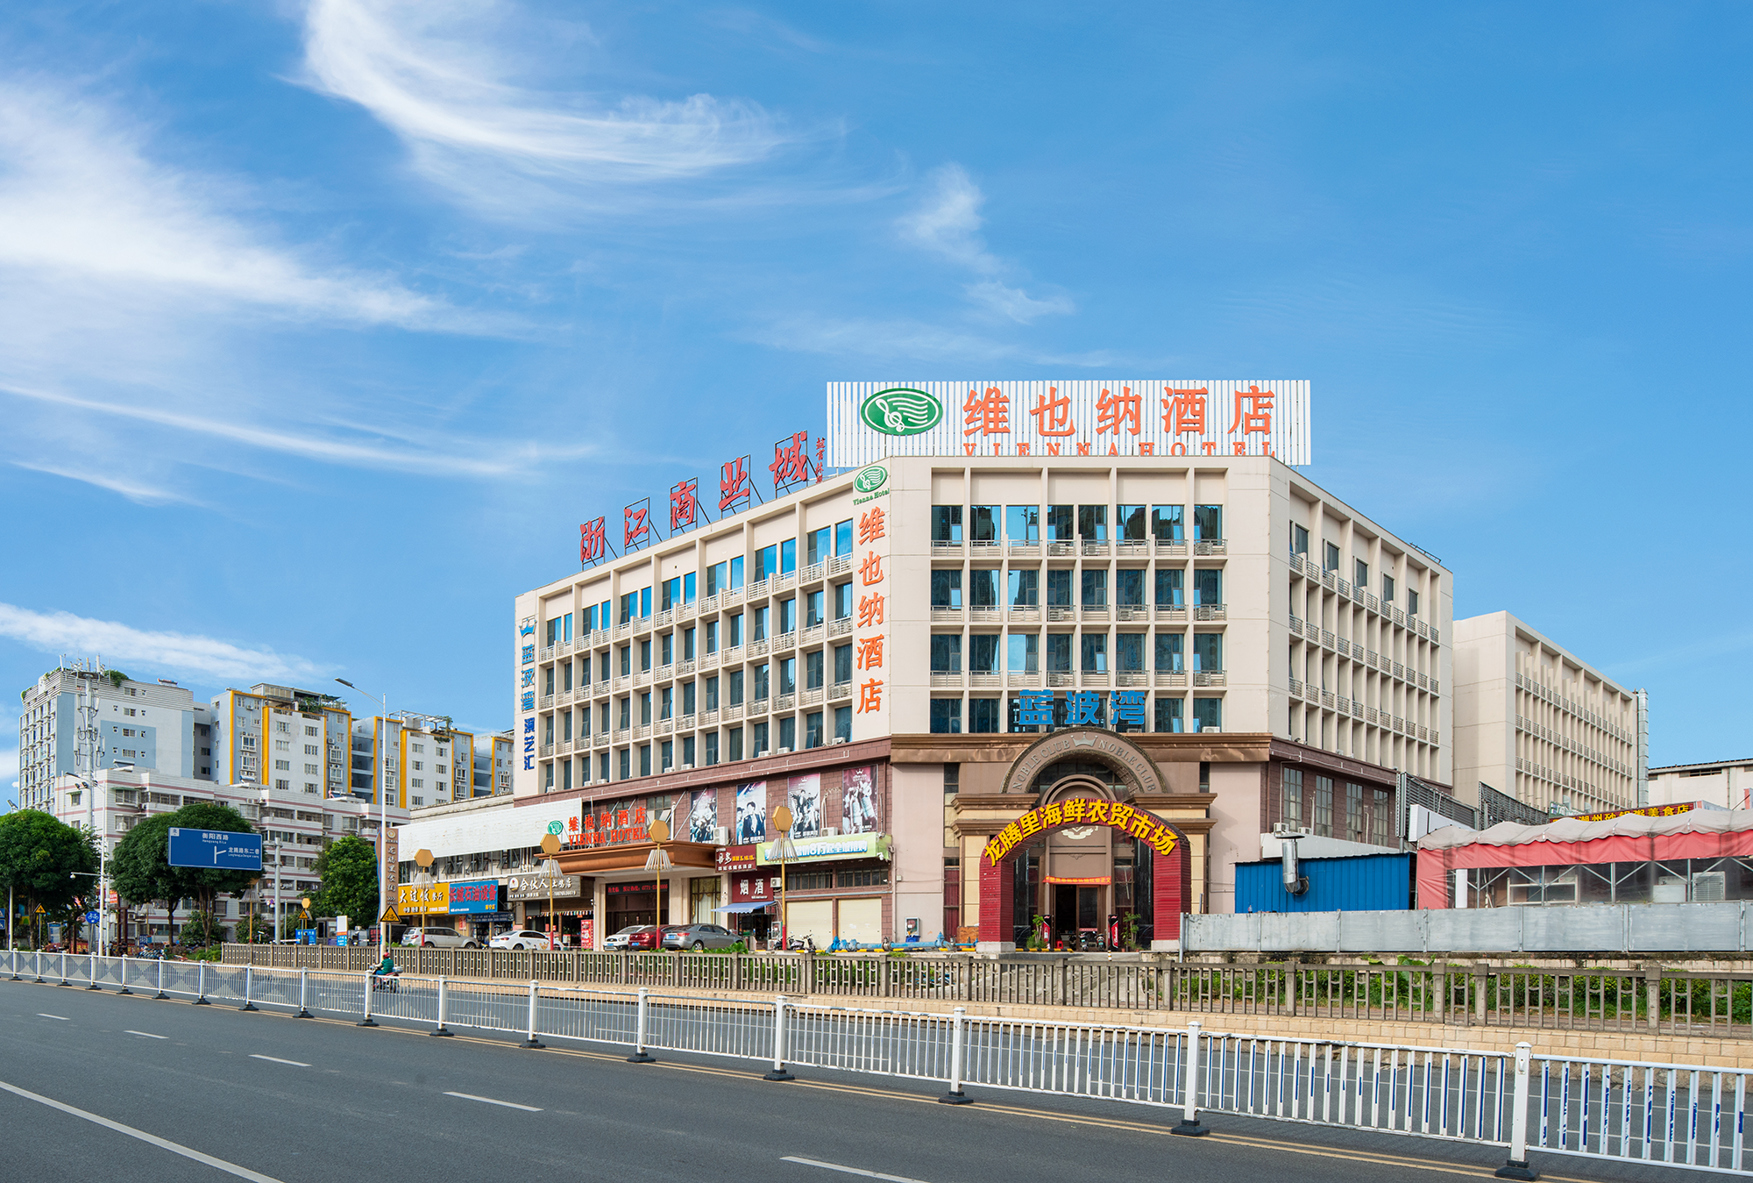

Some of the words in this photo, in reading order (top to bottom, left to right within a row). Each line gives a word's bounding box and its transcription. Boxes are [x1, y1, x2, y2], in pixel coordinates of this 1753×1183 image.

[963, 386, 1275, 437] 维也纳酒店
[963, 442, 1119, 456] VIENNA
[1138, 442, 1275, 456] HOTEL
[580, 431, 808, 561] 浙江商业城
[874, 488, 890, 499] Hotel
[857, 506, 886, 714] 维也纳酒店
[521, 644, 535, 711] 蓝波湾
[1019, 689, 1145, 725] 蓝波湾
[1012, 755, 1041, 790] NOBLE
[1041, 740, 1070, 758] CLUB
[1099, 740, 1138, 764] NOBLE
[1135, 762, 1156, 792] CLUB
[568, 806, 646, 832] 维也纳酒店
[568, 831, 606, 846] VIENNA
[610, 827, 645, 842] HOTEL
[984, 798, 1179, 867] 龙腾里海鲜农贸市场
[449, 884, 497, 903] 长城石油设备
